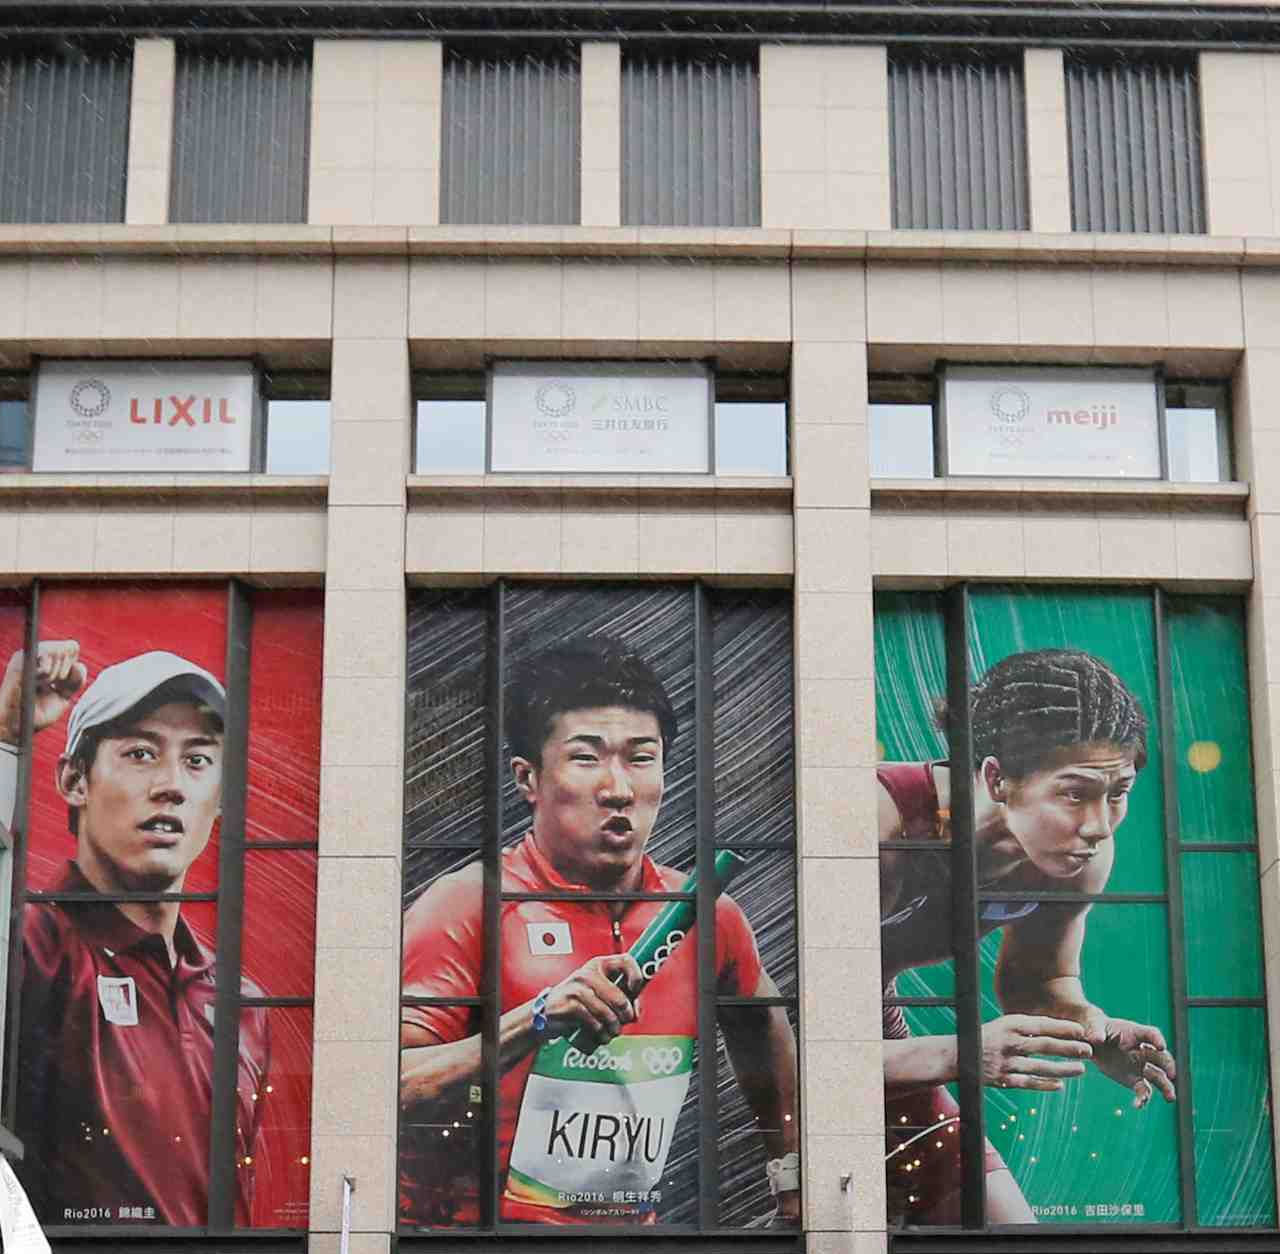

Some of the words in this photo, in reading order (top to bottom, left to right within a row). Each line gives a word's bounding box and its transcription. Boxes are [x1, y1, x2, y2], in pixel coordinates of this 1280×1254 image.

[129, 394, 237, 427] LIXIL
[1046, 405, 1117, 430] meiji
[547, 1109, 665, 1163] KIRYU
[558, 1191, 605, 1202] Rio2016
[63, 1208, 111, 1219] Rio2016
[1031, 1205, 1077, 1216] Rio2016
